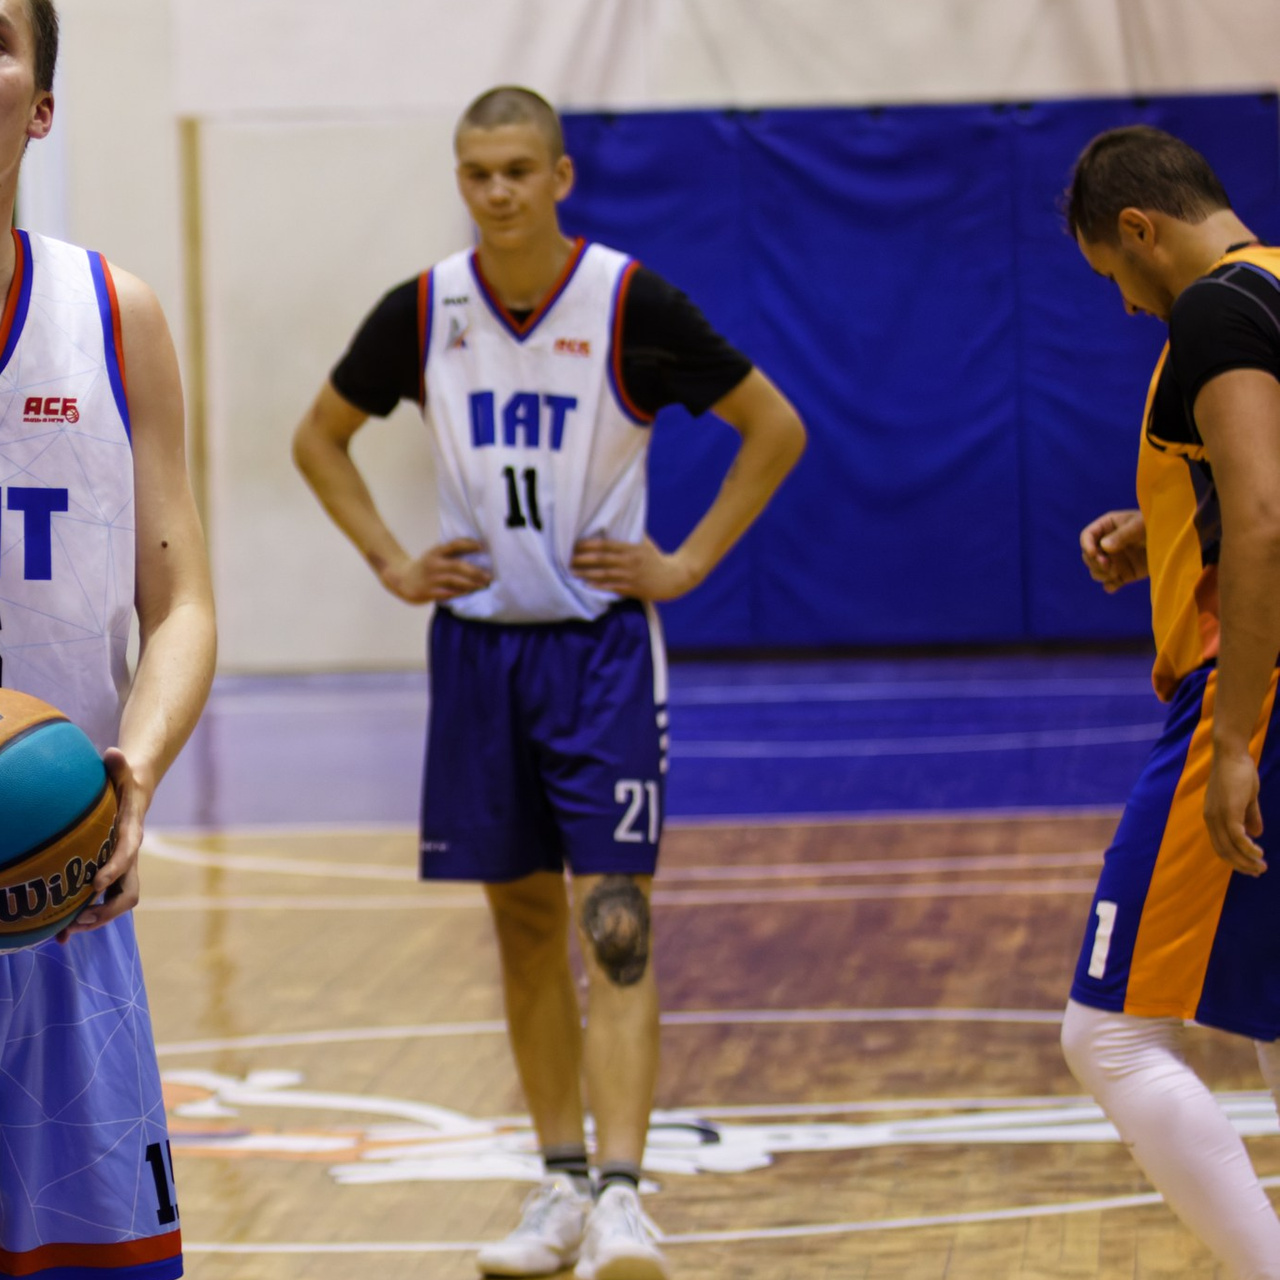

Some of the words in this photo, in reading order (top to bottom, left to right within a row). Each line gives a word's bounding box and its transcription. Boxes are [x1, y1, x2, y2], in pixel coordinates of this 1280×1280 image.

[23, 397, 79, 421] АСБ
[502, 466, 543, 532] 11
[614, 780, 659, 844] 21
[1087, 901, 1118, 979] 1
